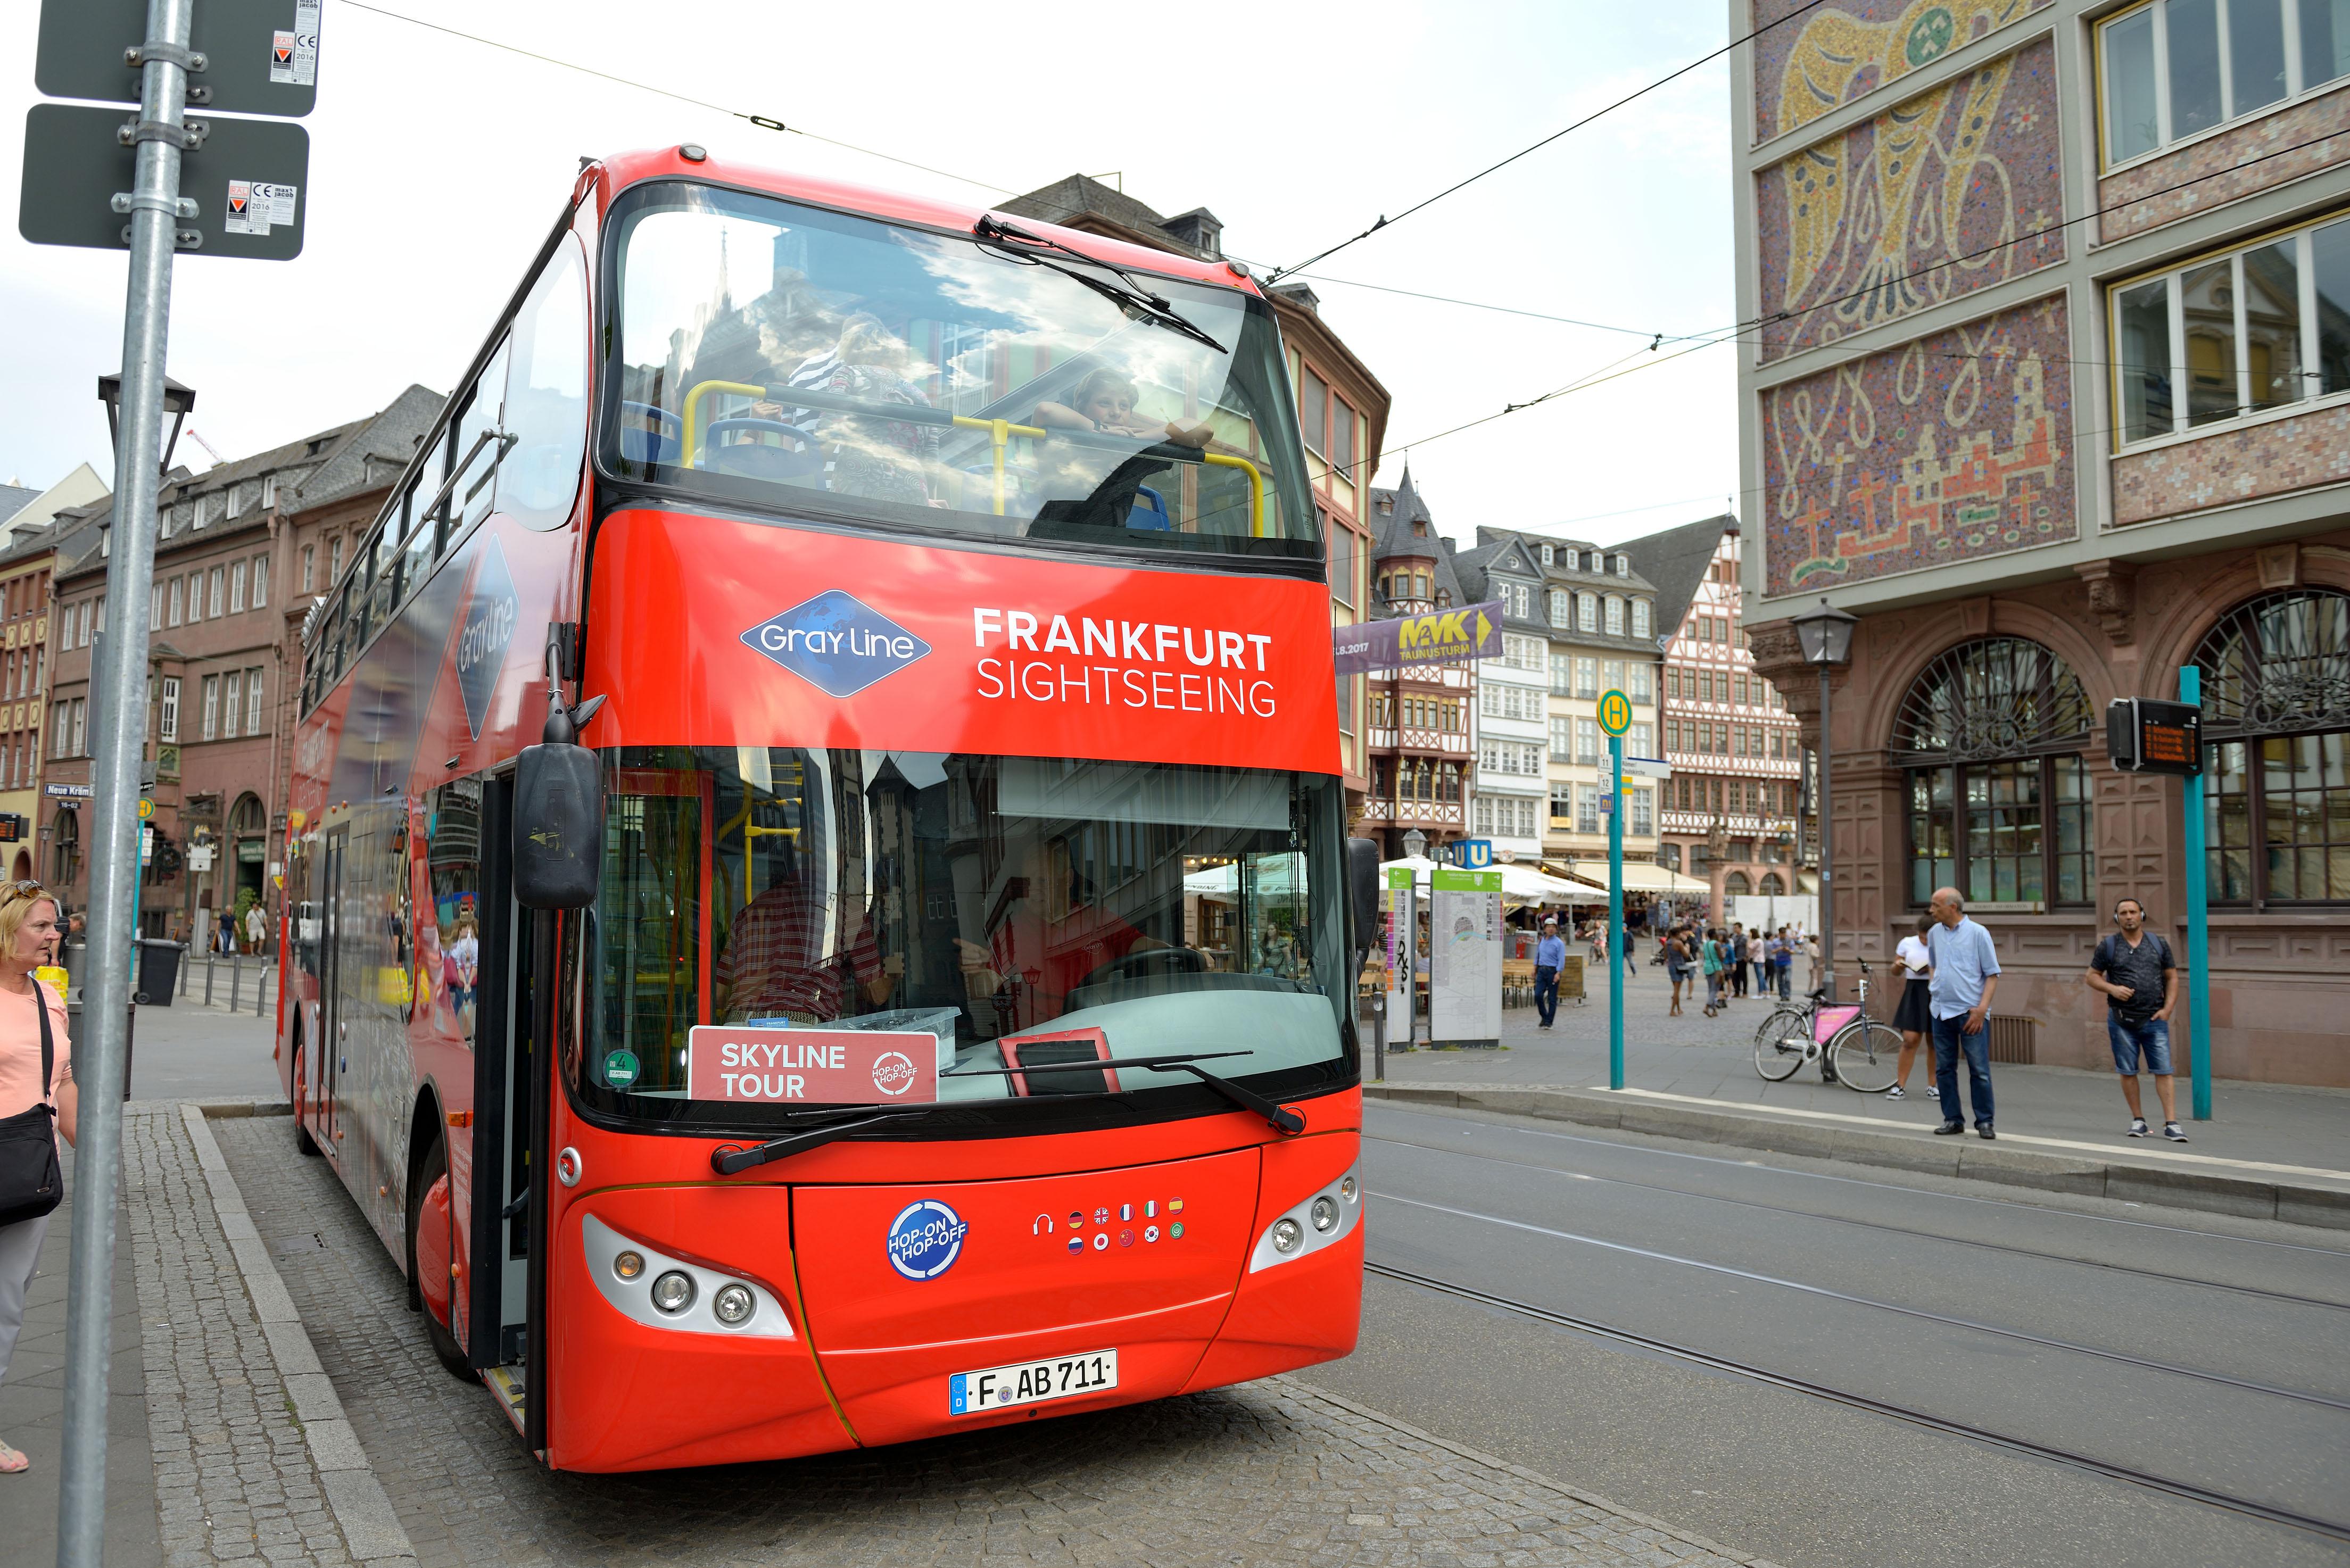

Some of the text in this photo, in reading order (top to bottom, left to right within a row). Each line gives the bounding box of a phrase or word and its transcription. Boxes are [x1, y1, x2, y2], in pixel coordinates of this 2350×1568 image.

[297, 35, 316, 48] CE
[253, 184, 272, 197] CE
[973, 607, 1272, 672] FRANKFURT
[1399, 644, 1470, 661] TAUNUSTURM
[977, 657, 1276, 718] SIGHTSEEING
[1609, 700, 1623, 726] H
[47, 785, 68, 795] Neue
[69, 785, 89, 796] Kräm
[1454, 844, 1488, 867] U U
[617, 1055, 626, 1069] 4
[721, 1043, 845, 1069] SKYLINE
[872, 1063, 906, 1078] HOP-ON
[880, 1067, 918, 1084] HOP-OFF
[721, 1073, 805, 1098] TOUR
[889, 1217, 946, 1254] HOP-ON
[902, 1223, 966, 1262] HOP-OFF
[979, 1357, 1106, 1406] F AB 711
[955, 1397, 963, 1407] D
